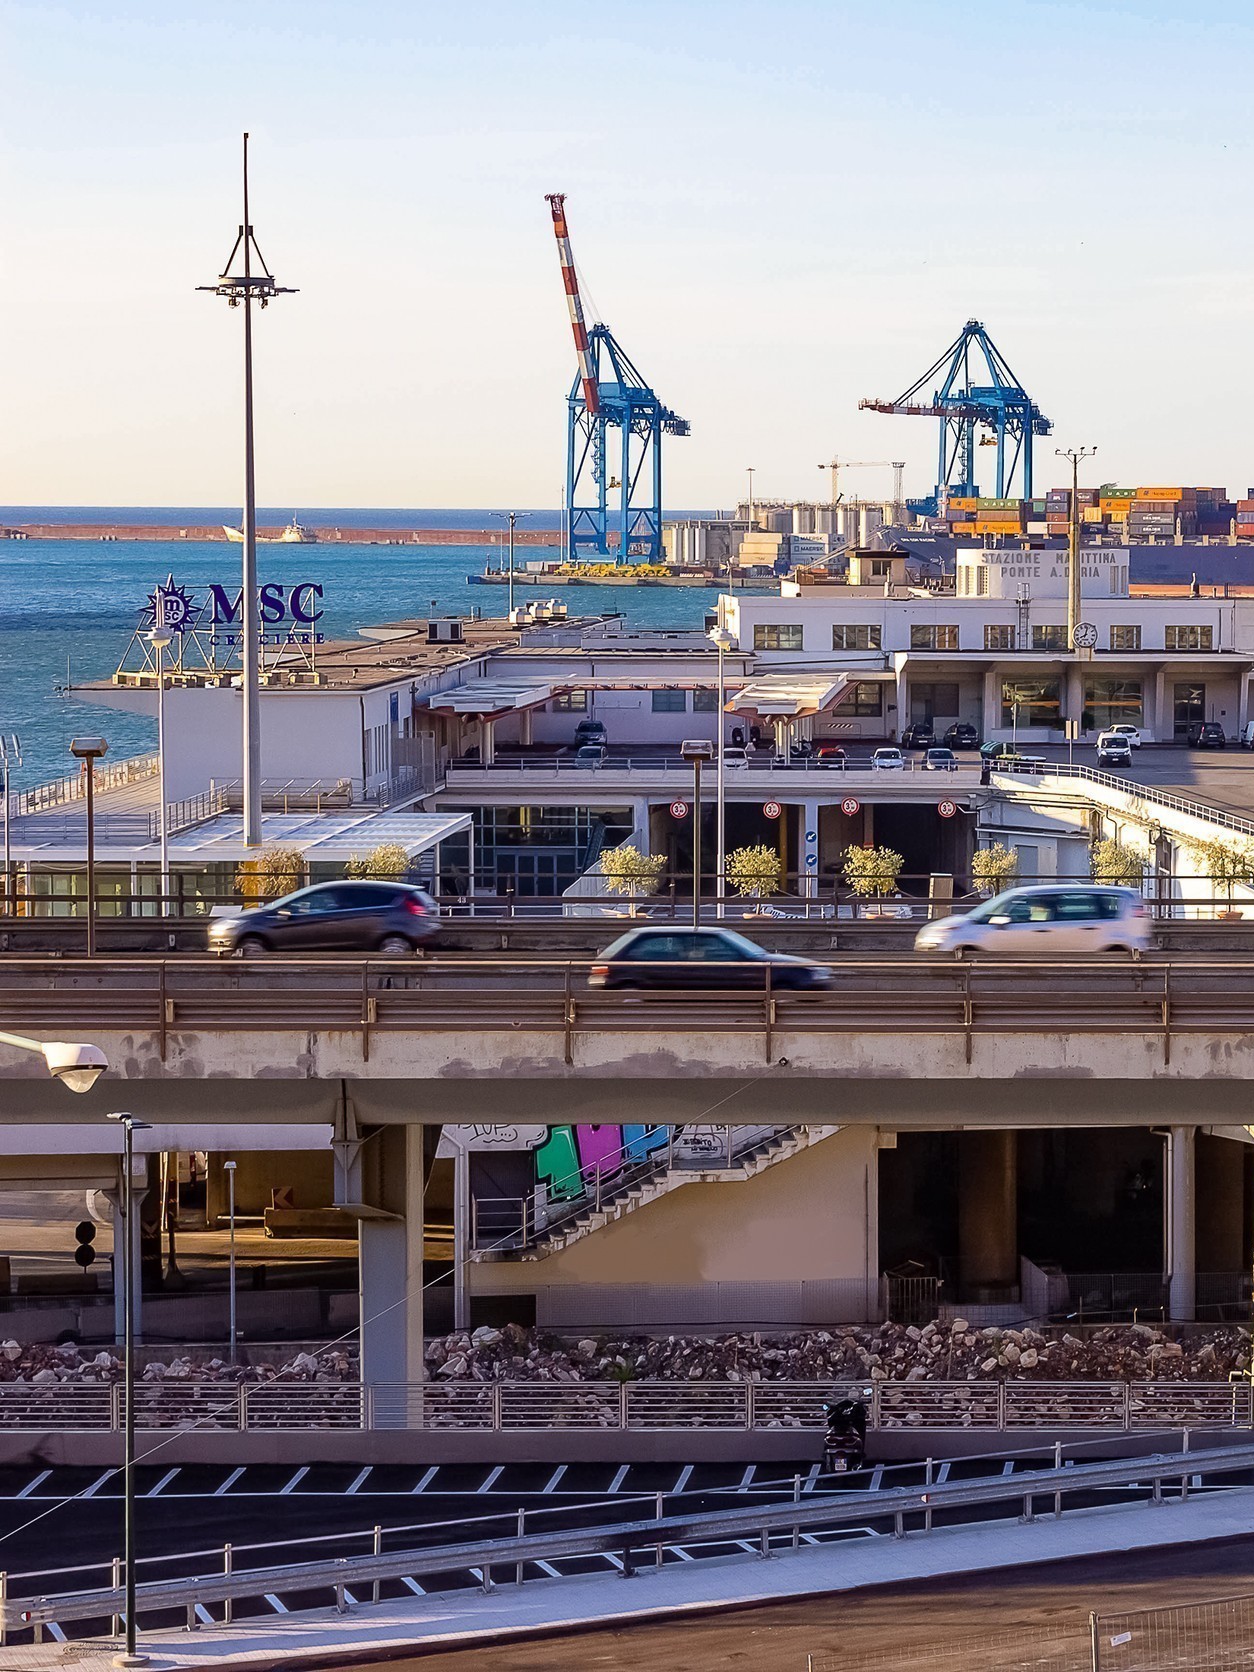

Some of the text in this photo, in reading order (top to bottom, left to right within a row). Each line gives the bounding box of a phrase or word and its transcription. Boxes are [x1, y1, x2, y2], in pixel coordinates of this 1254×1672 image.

[981, 552, 1116, 564] STAZIONE MAITTIMA
[1001, 566, 1100, 578] PONTE A.DRIA
[208, 582, 324, 624] MSC
[209, 633, 325, 646] CRCIERE
